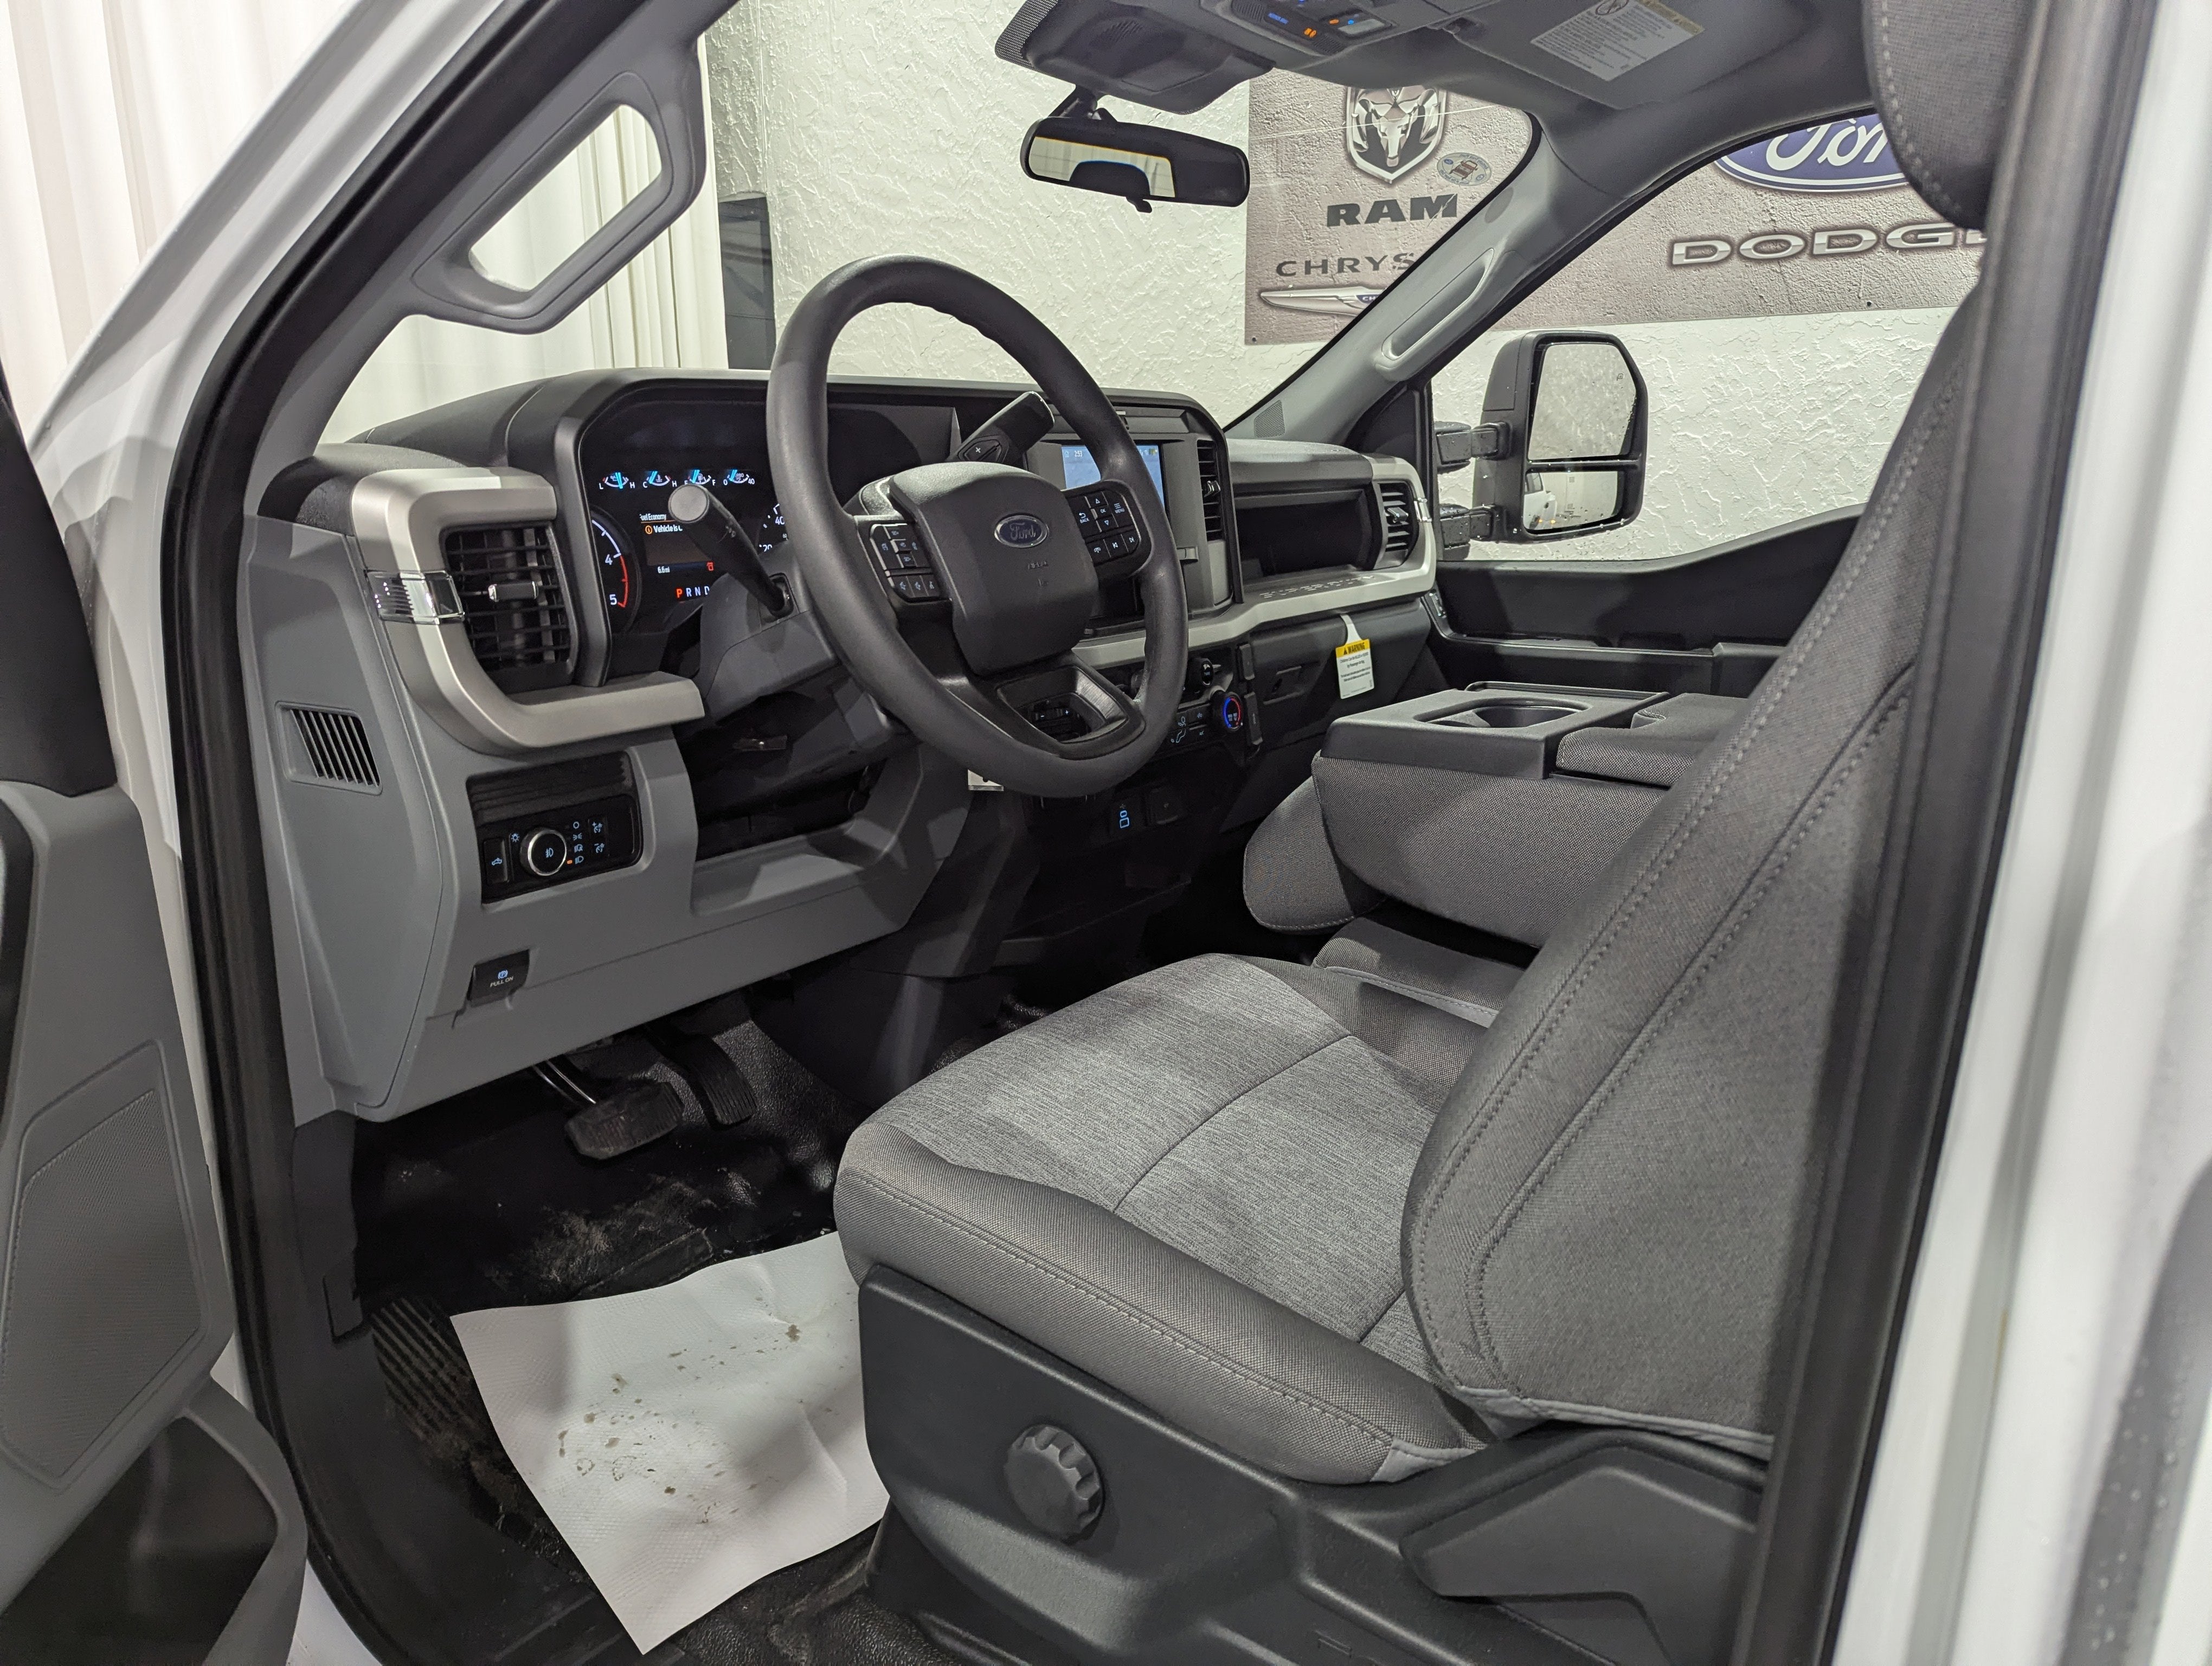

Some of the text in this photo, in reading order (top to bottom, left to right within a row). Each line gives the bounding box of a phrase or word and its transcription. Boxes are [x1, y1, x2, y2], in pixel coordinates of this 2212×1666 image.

[1766, 118, 1888, 171] For
[1327, 193, 1458, 227] RAM
[1276, 252, 1415, 277] CHRYS
[648, 513, 667, 521] Economy
[653, 524, 673, 533] Vehicle
[1009, 522, 1036, 541] Ford
[605, 554, 613, 565] 4
[609, 594, 618, 605] 5
[490, 979, 505, 988] PULL
